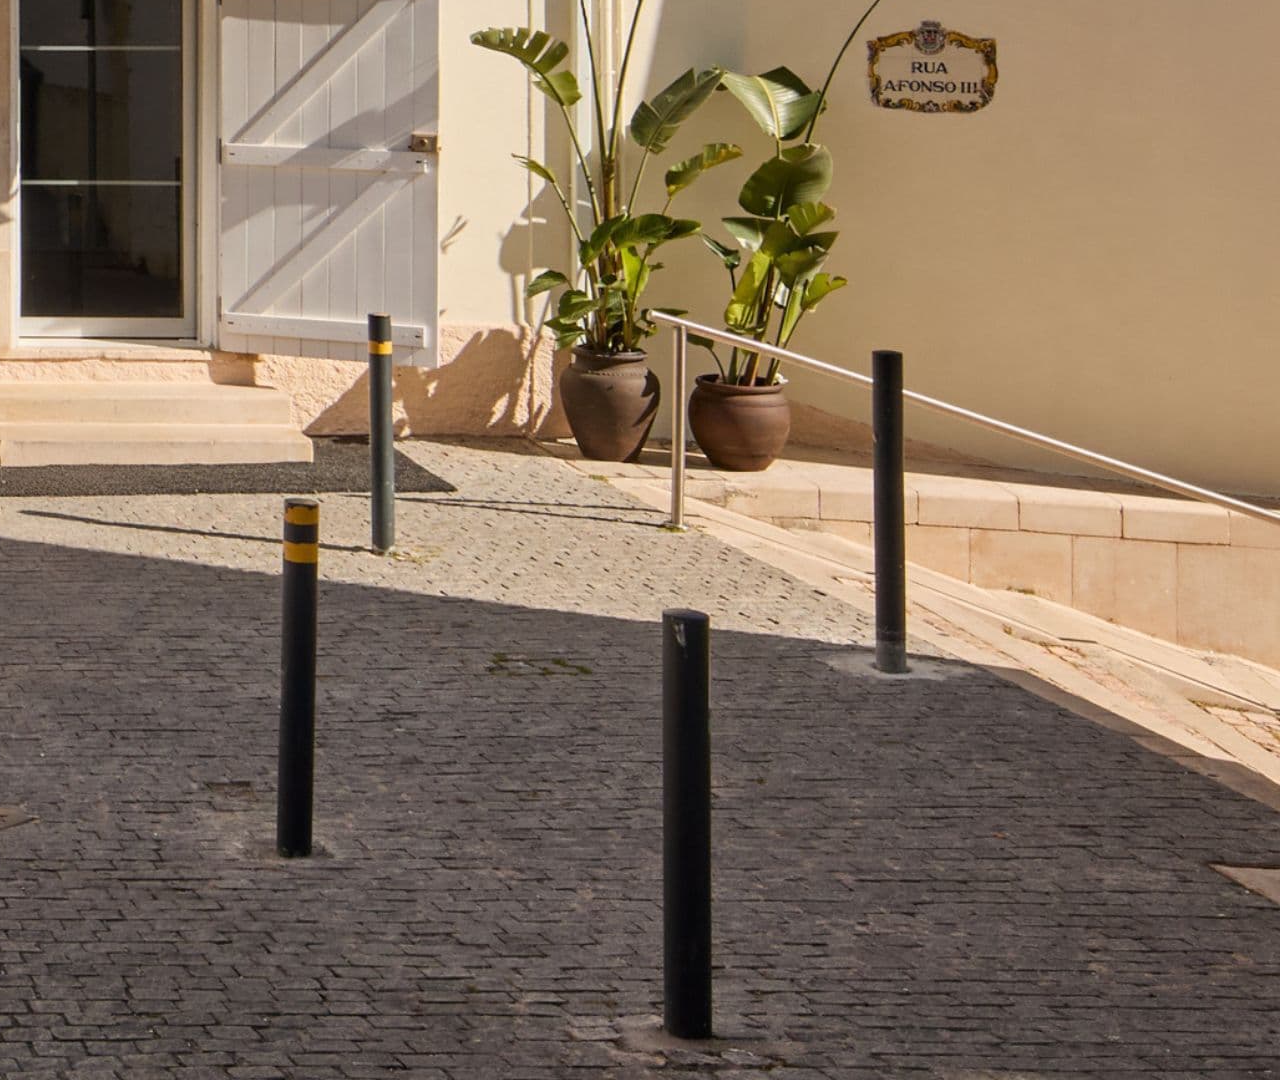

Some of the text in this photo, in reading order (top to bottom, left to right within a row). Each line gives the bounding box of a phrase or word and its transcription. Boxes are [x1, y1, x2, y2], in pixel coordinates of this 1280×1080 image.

[911, 61, 948, 74] RUA
[884, 80, 978, 94] AFONSO III
